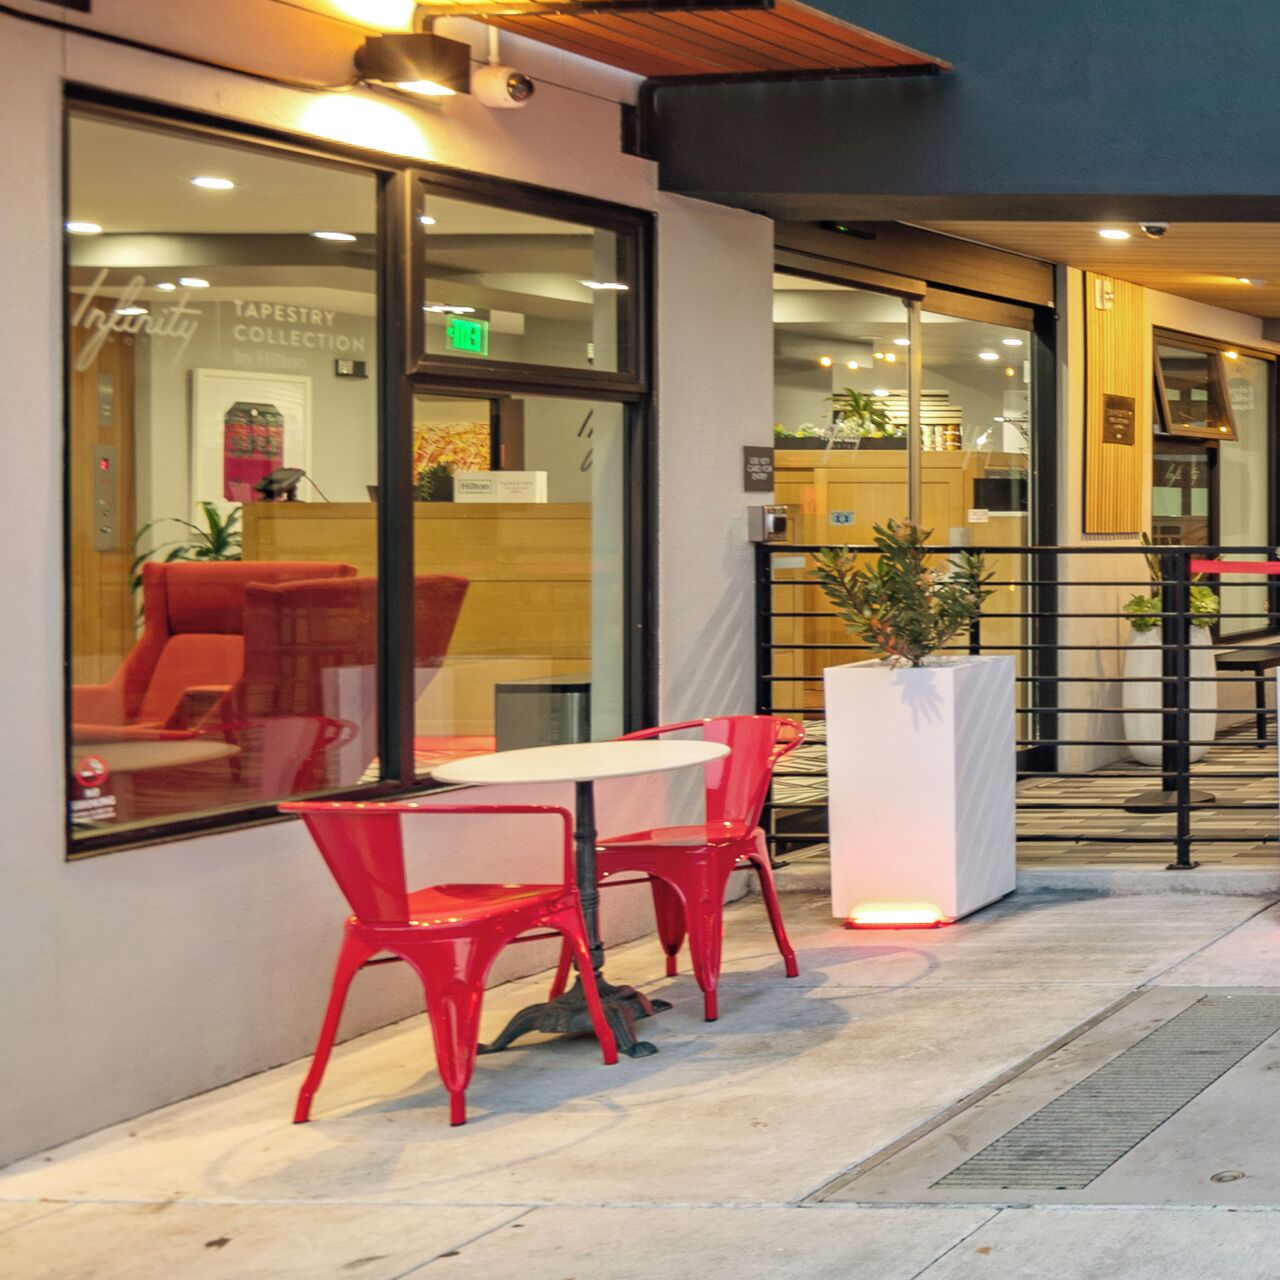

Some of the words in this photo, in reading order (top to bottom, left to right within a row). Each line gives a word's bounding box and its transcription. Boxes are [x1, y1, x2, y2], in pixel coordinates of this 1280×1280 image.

[71, 268, 203, 371] Infinity
[233, 299, 336, 327] TAPESTRY
[233, 324, 366, 352] COLLECTION
[259, 350, 307, 370] Hilton
